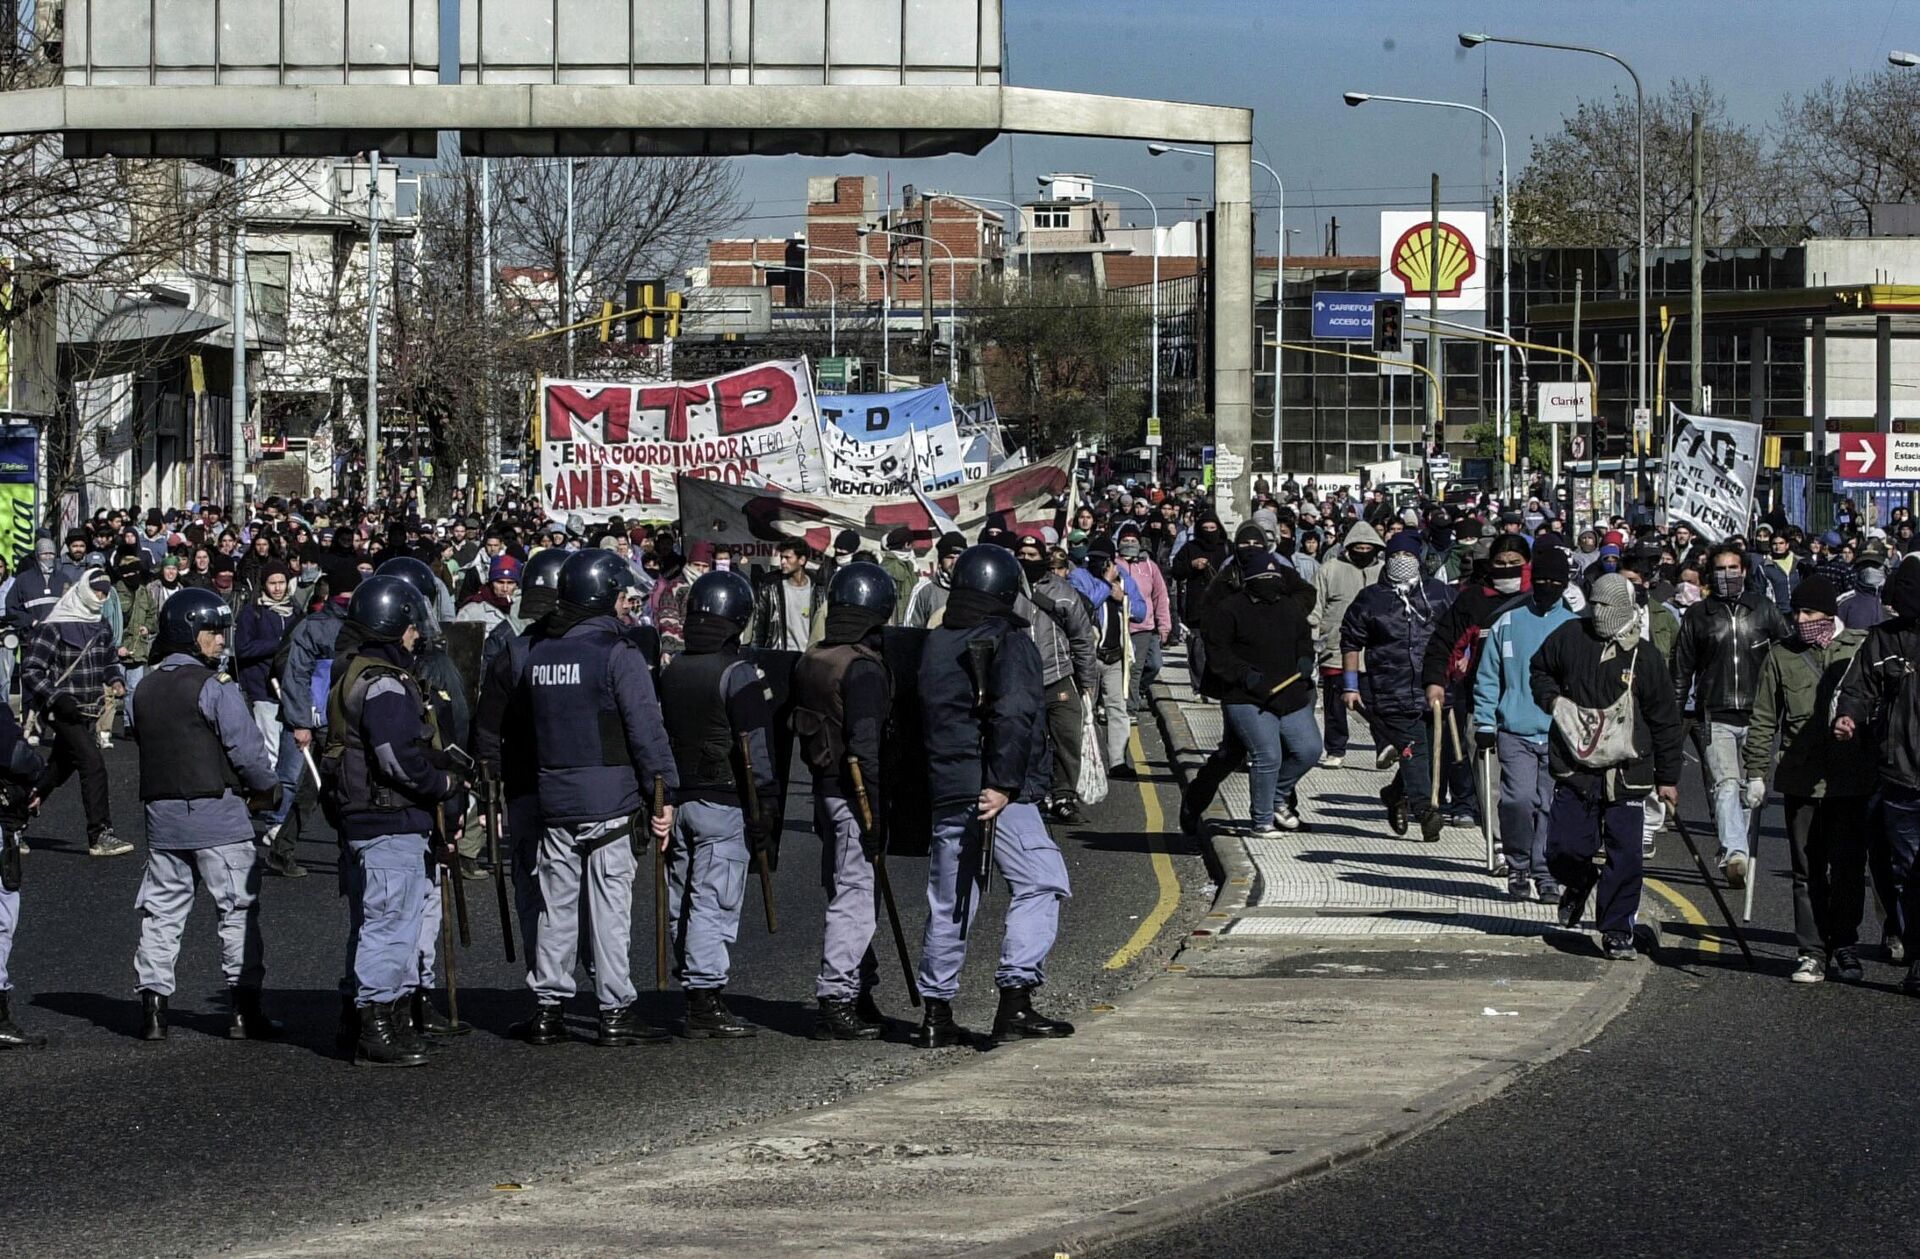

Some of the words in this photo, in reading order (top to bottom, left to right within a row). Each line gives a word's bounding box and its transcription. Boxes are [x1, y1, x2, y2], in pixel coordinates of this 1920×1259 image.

[545, 366, 799, 444] MTD
[562, 443, 586, 464] EN
[589, 443, 609, 465] LA
[611, 436, 753, 467] COORDINADORA
[532, 663, 581, 685] POLICIA
